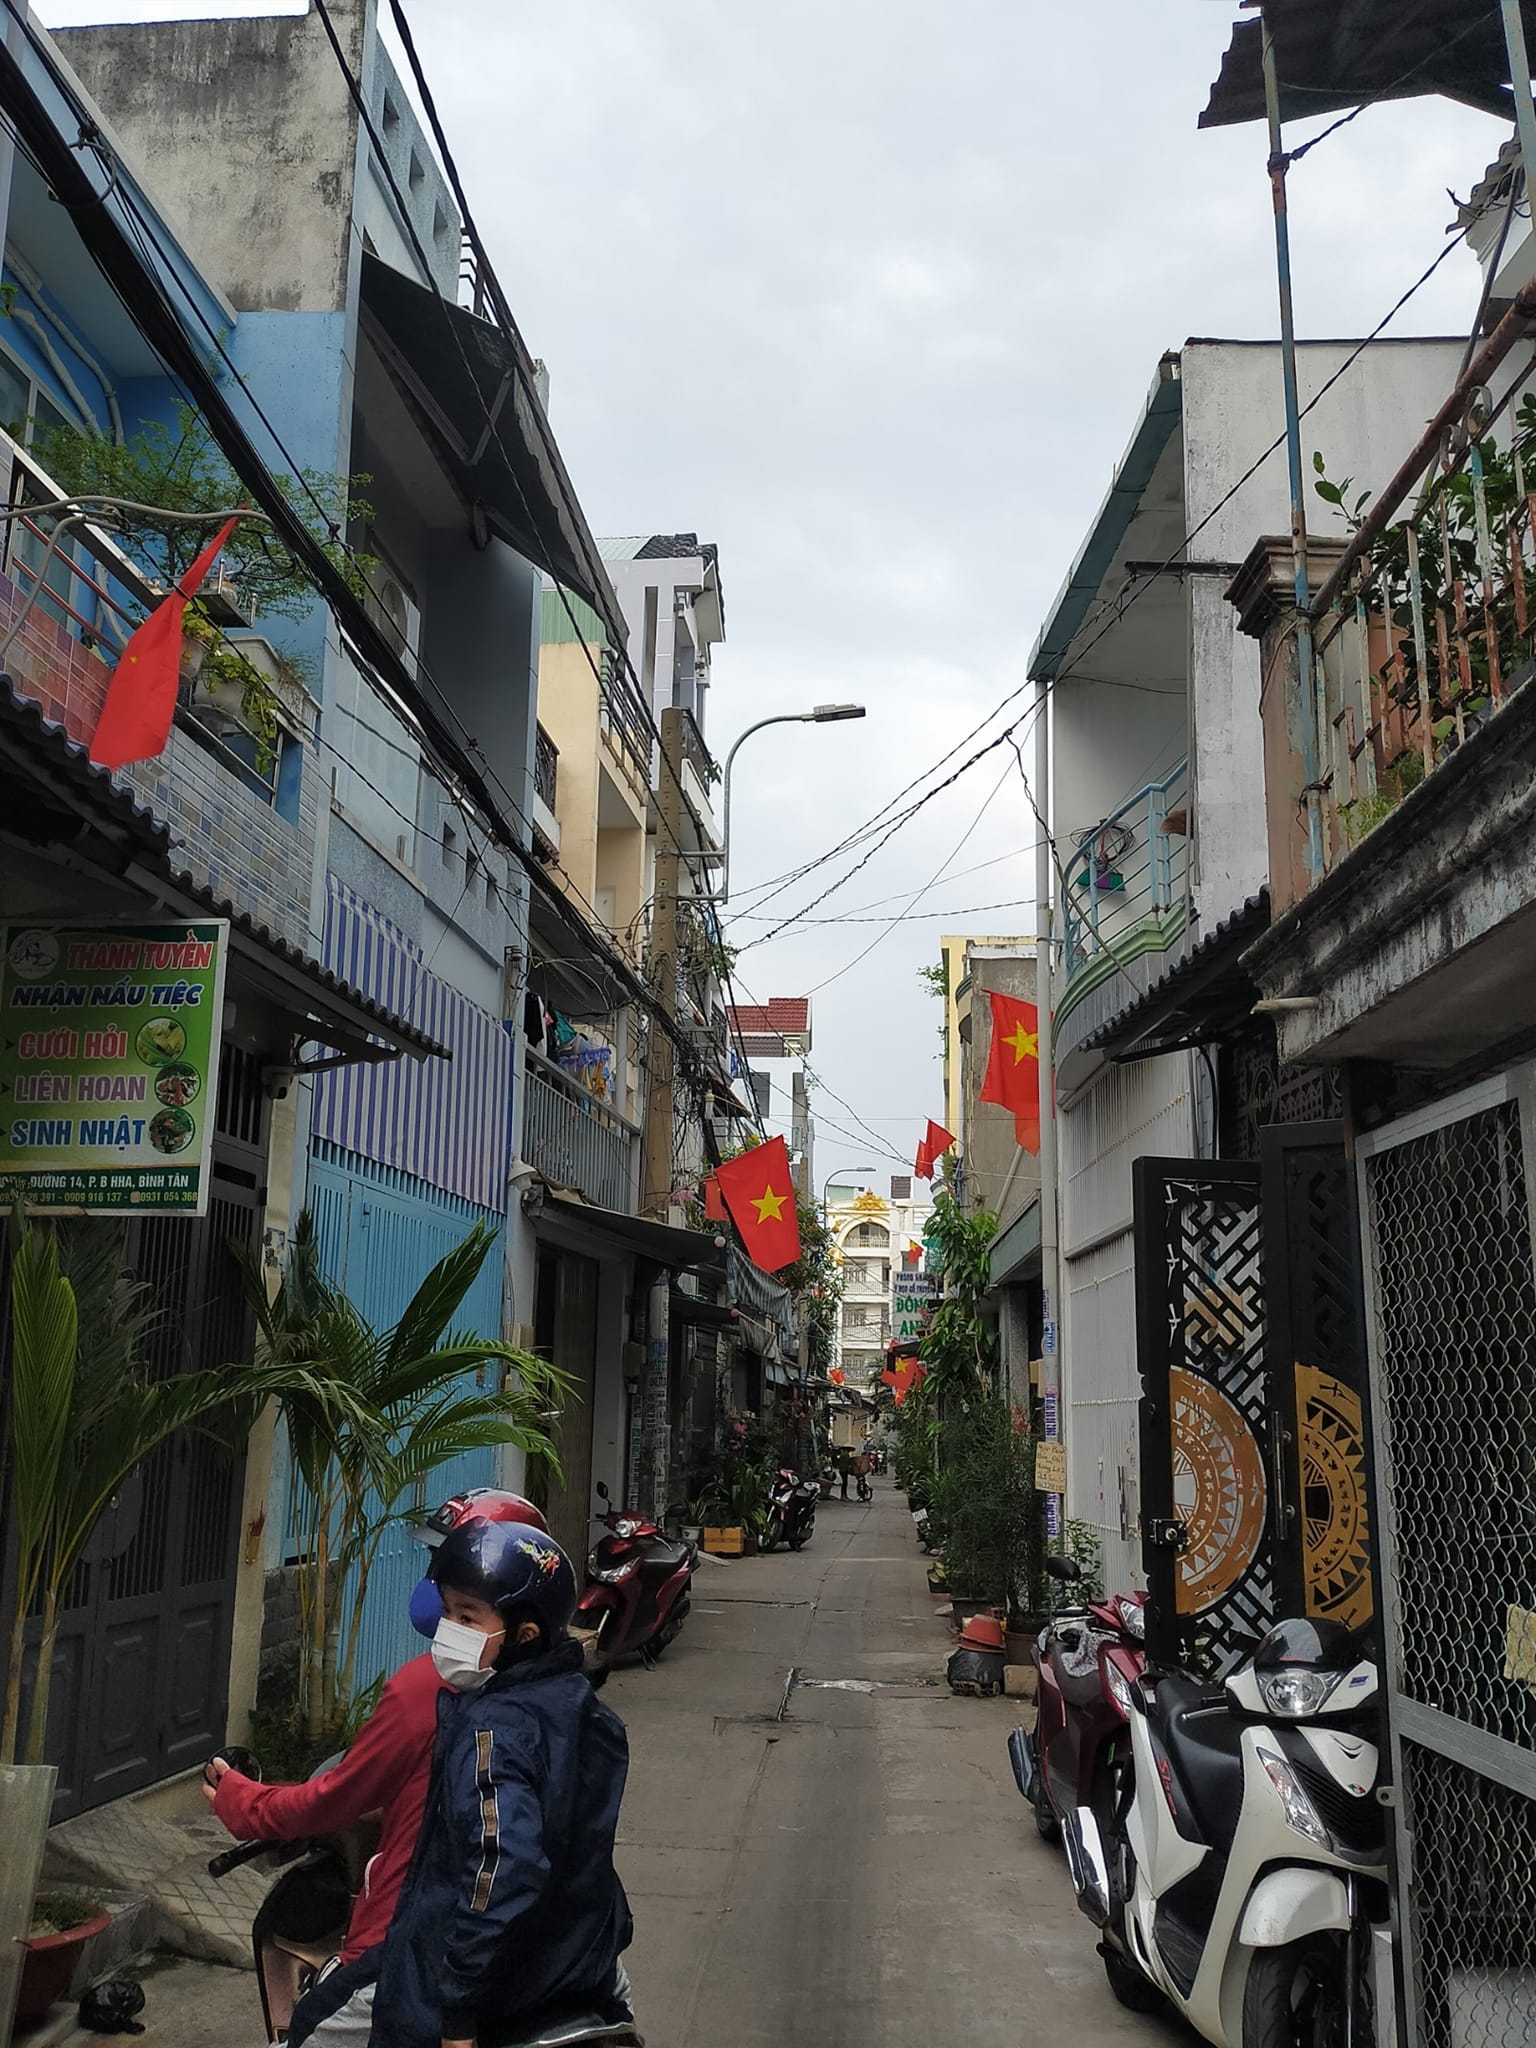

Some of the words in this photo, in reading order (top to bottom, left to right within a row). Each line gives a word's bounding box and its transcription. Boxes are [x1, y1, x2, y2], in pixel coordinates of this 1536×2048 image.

[67, 943, 139, 970] THANH
[11, 980, 87, 1013] NHẬN
[91, 976, 147, 1007] NẤU
[151, 979, 205, 1012] TIỆC
[18, 1026, 78, 1059] CƯỚI
[83, 1023, 128, 1059] HỎI
[13, 1069, 72, 1103] LIÊN
[77, 1075, 147, 1102] HOAN
[10, 1118, 73, 1147] SINH
[79, 1115, 147, 1151] NHẬT
[64, 1192, 86, 1202] 0909
[107, 1192, 122, 1202] 137
[140, 1191, 161, 1202] 0931
[163, 1191, 179, 1201] 054
[182, 1191, 198, 1201] 368
[70, 1176, 86, 1189] 14,
[88, 1176, 97, 1188] P.
[100, 1176, 108, 1188] B
[139, 1172, 165, 1188] BÌNH
[167, 1172, 189, 1188] TÂN
